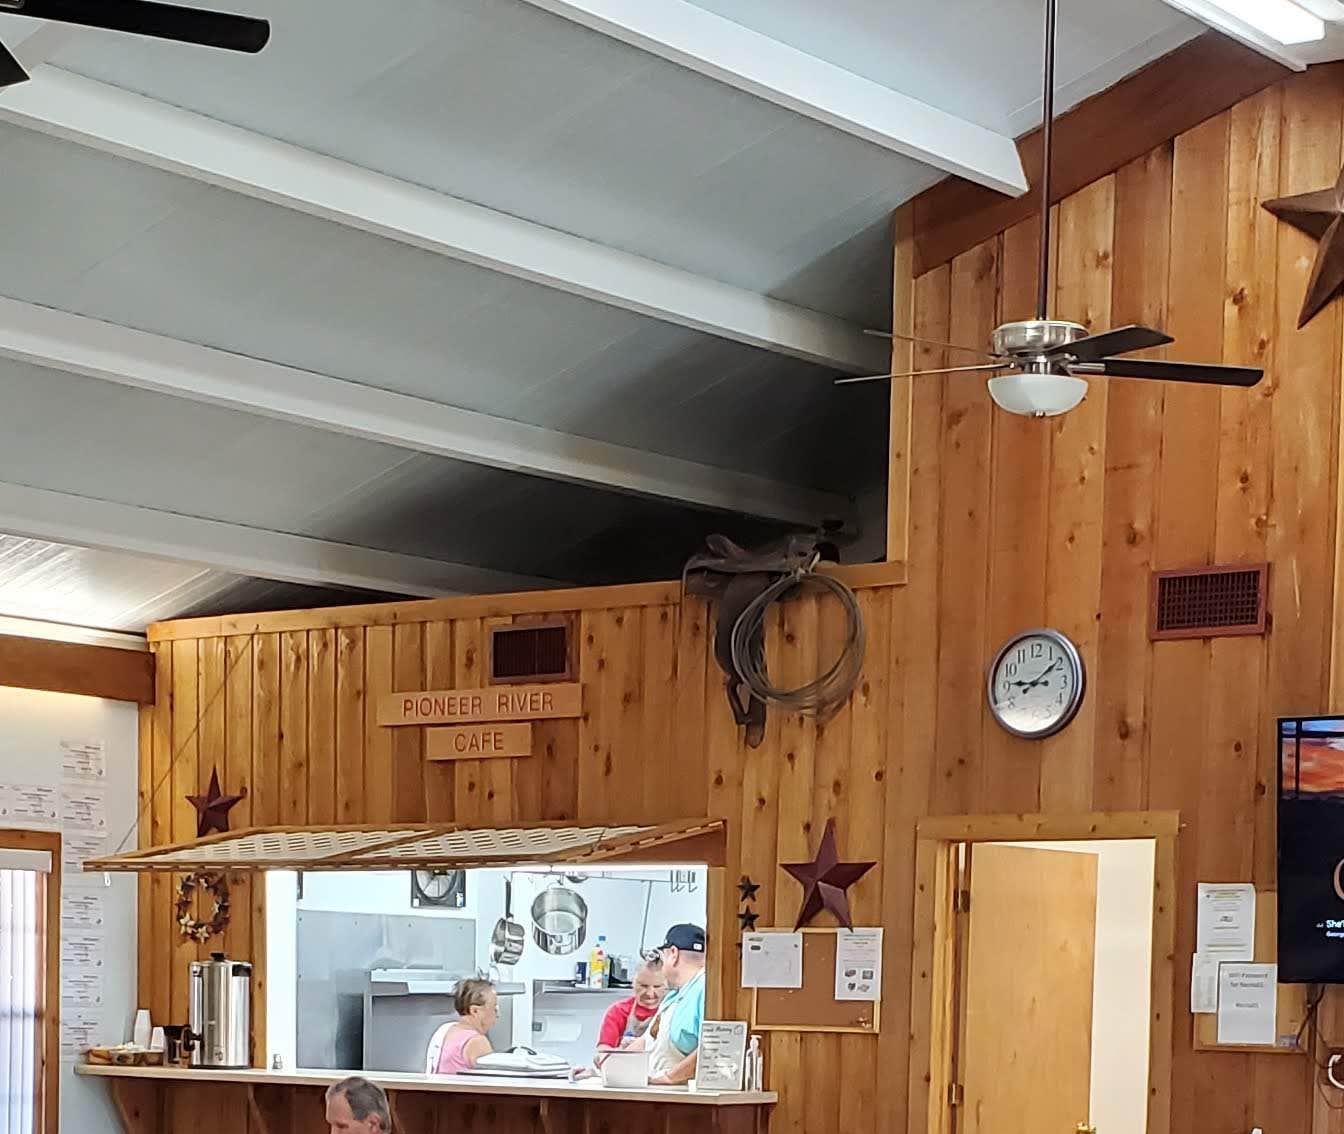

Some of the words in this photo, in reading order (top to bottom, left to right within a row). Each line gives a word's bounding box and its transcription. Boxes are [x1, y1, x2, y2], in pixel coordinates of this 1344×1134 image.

[1018, 648, 1026, 664] 11
[1031, 643, 1043, 658] 12
[1048, 645, 1053, 660] 1
[1006, 662, 1018, 677] 10
[1055, 656, 1064, 670] 2
[1061, 674, 1068, 689] 3
[402, 695, 483, 718] PIONEER
[496, 691, 554, 713] RIVER
[452, 731, 505, 753] CAFE
